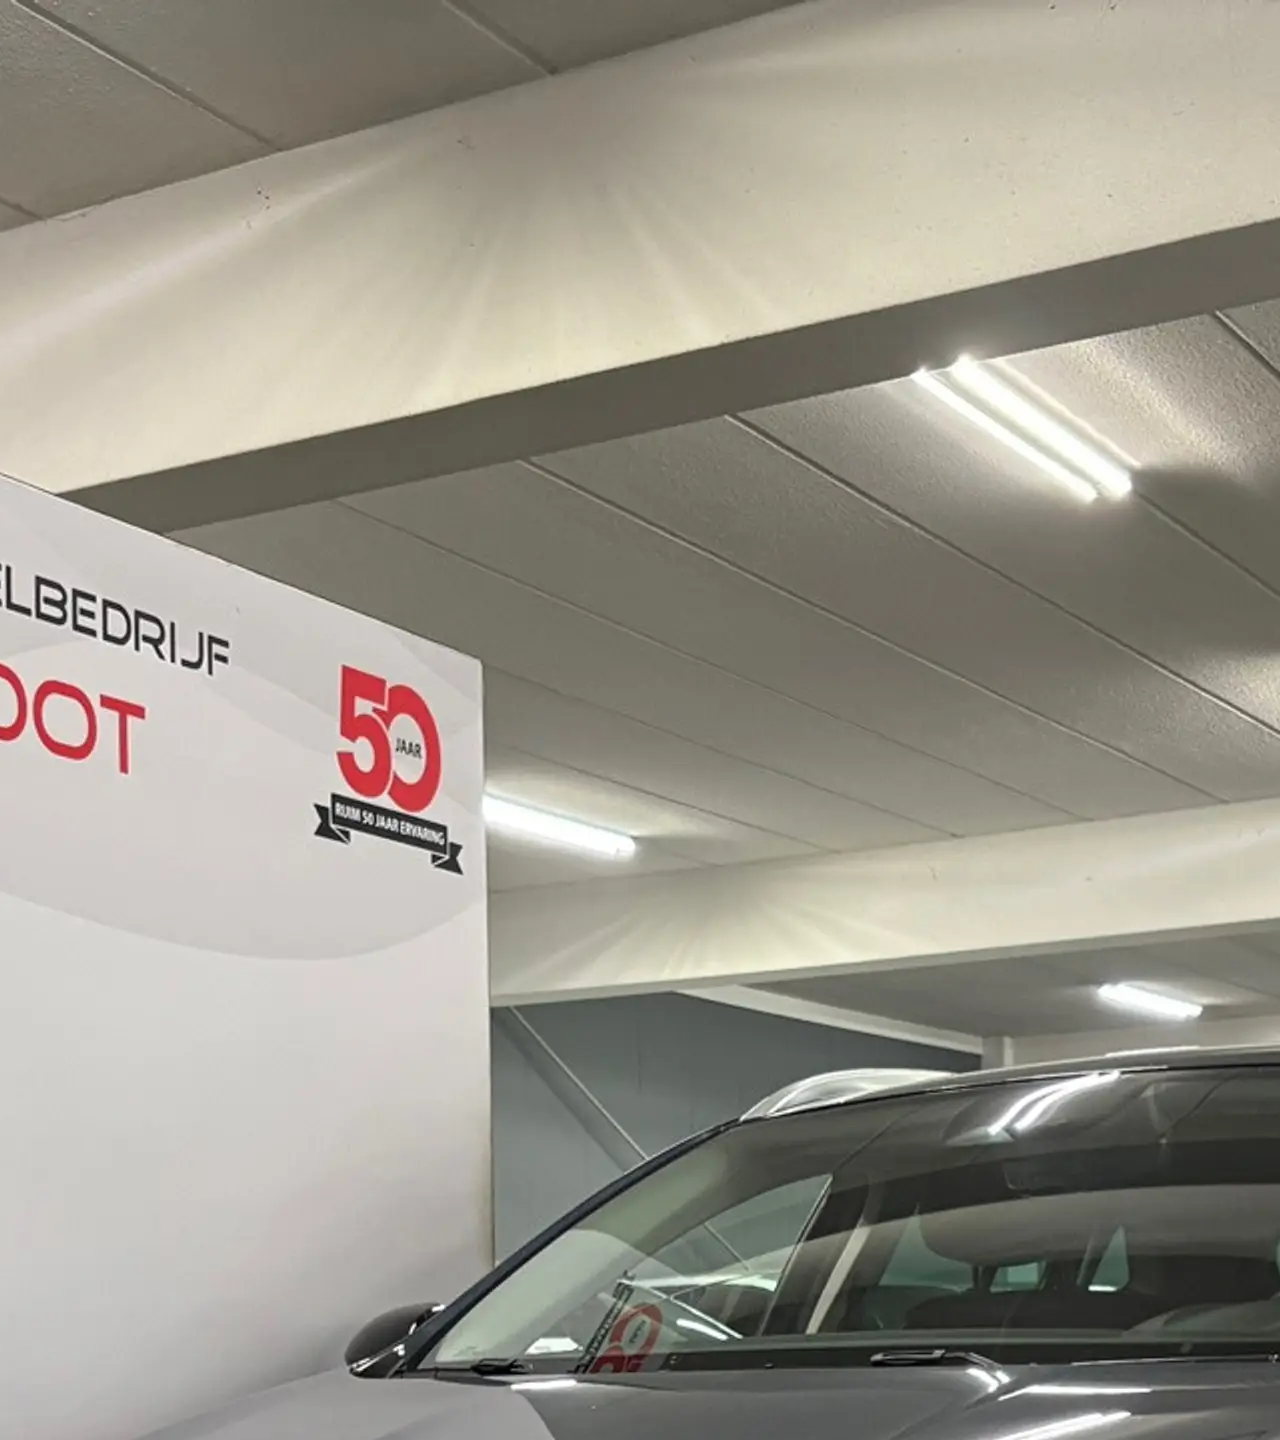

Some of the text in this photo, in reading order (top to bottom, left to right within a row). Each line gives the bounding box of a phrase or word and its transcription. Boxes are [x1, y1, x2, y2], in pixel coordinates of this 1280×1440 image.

[336, 664, 442, 813] 50
[395, 738, 422, 760] JAAR
[335, 801, 445, 846] RUIM 50 JAAR ERVARING
